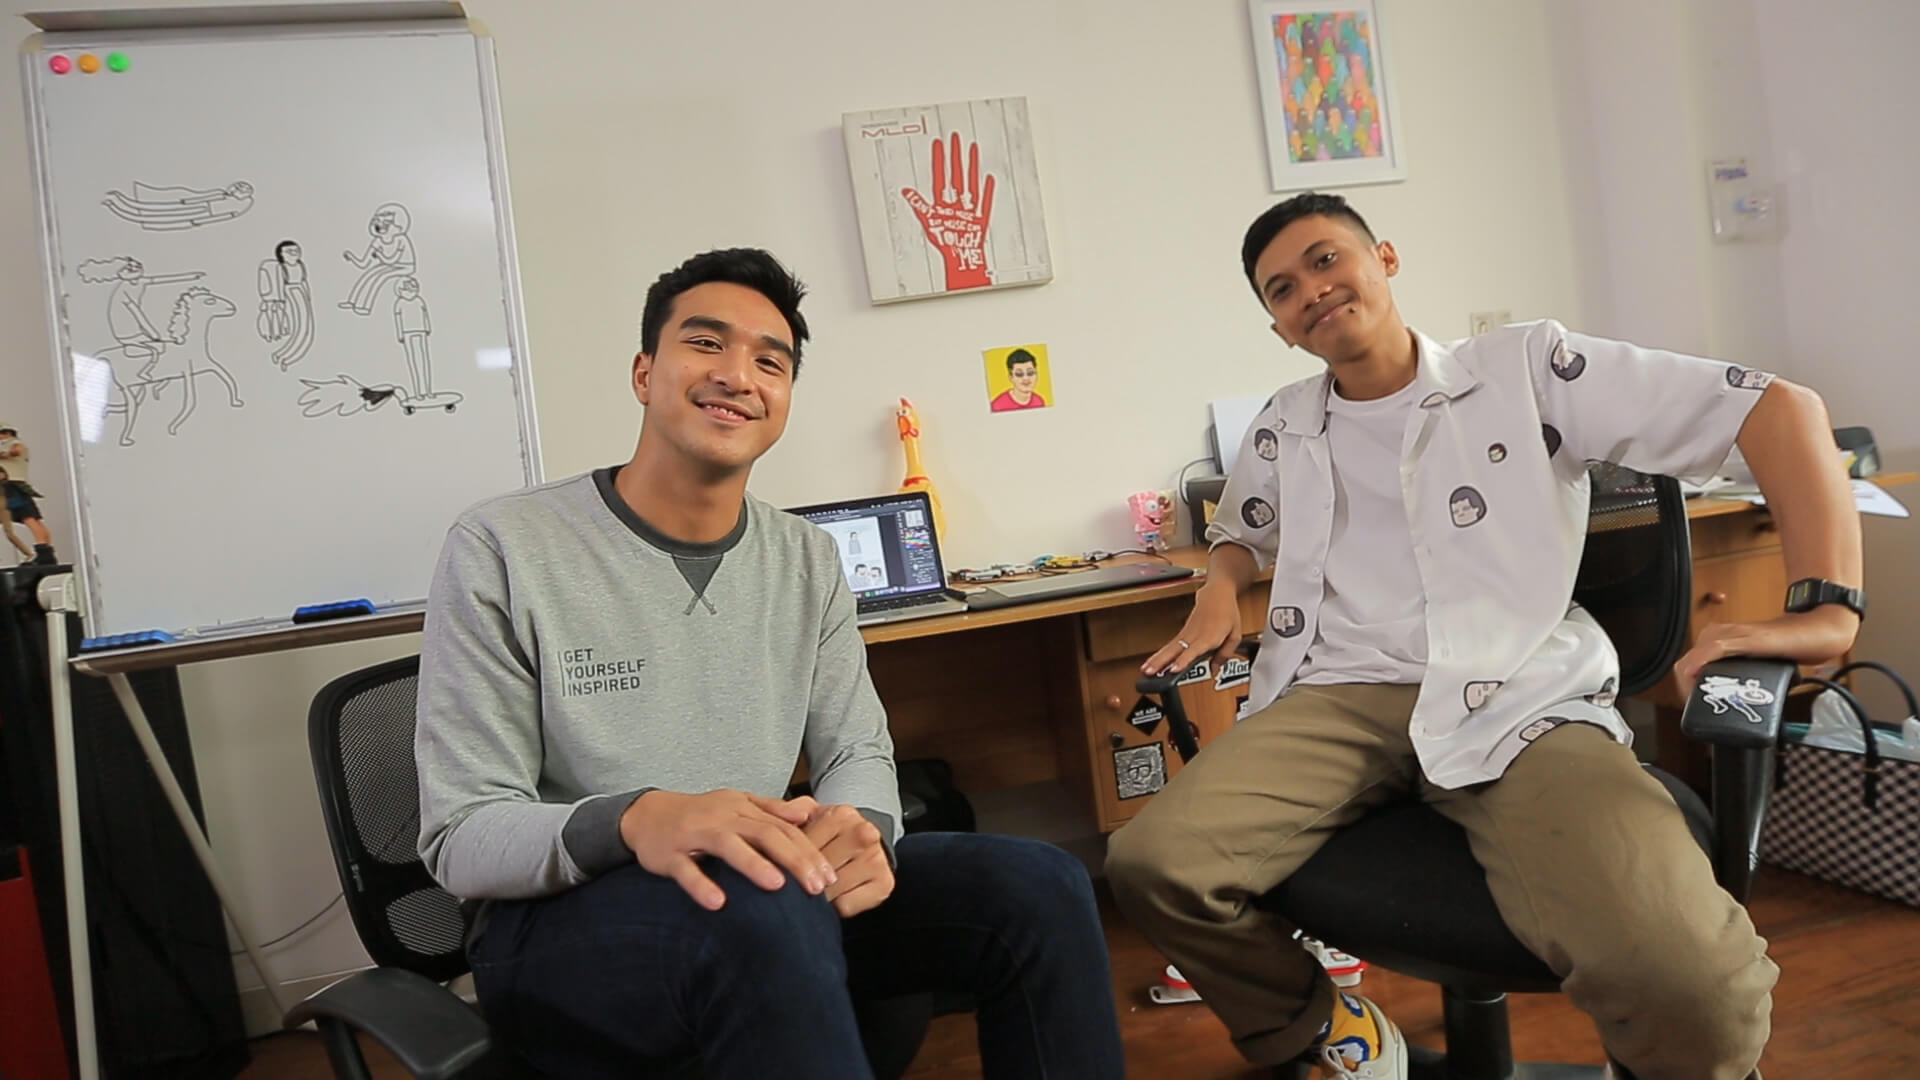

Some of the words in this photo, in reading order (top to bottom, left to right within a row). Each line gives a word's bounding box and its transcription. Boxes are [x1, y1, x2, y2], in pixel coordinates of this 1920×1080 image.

[928, 226, 983, 249] TOUCH
[564, 648, 593, 663] GET
[565, 659, 646, 680] YOURSELF
[568, 676, 641, 696] INSPIRED
